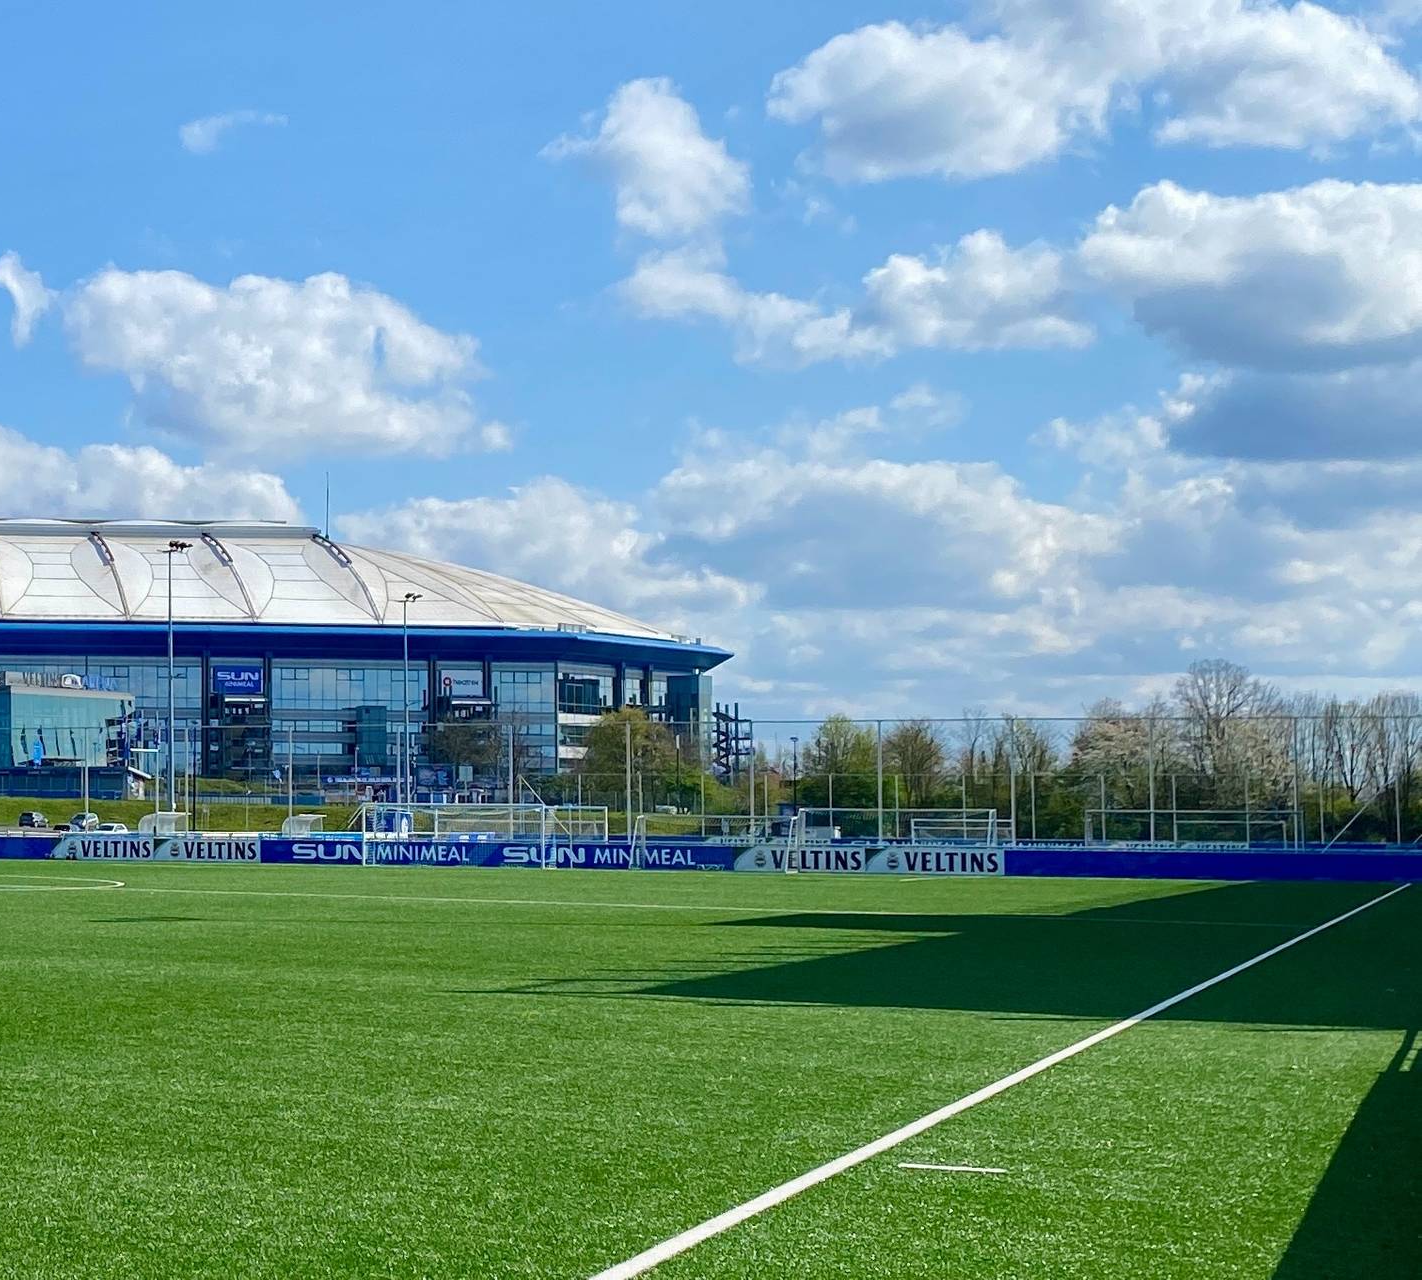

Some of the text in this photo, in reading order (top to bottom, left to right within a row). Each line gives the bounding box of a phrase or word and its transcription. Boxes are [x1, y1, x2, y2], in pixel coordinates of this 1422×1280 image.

[217, 671, 259, 681] SUN
[80, 840, 152, 859] VELTINS
[184, 841, 257, 861] VELTINS
[292, 843, 469, 862] SUN MINIMEAL
[503, 846, 585, 864] SUN
[771, 850, 862, 871] VELTINS
[904, 851, 999, 873] VELTINS
